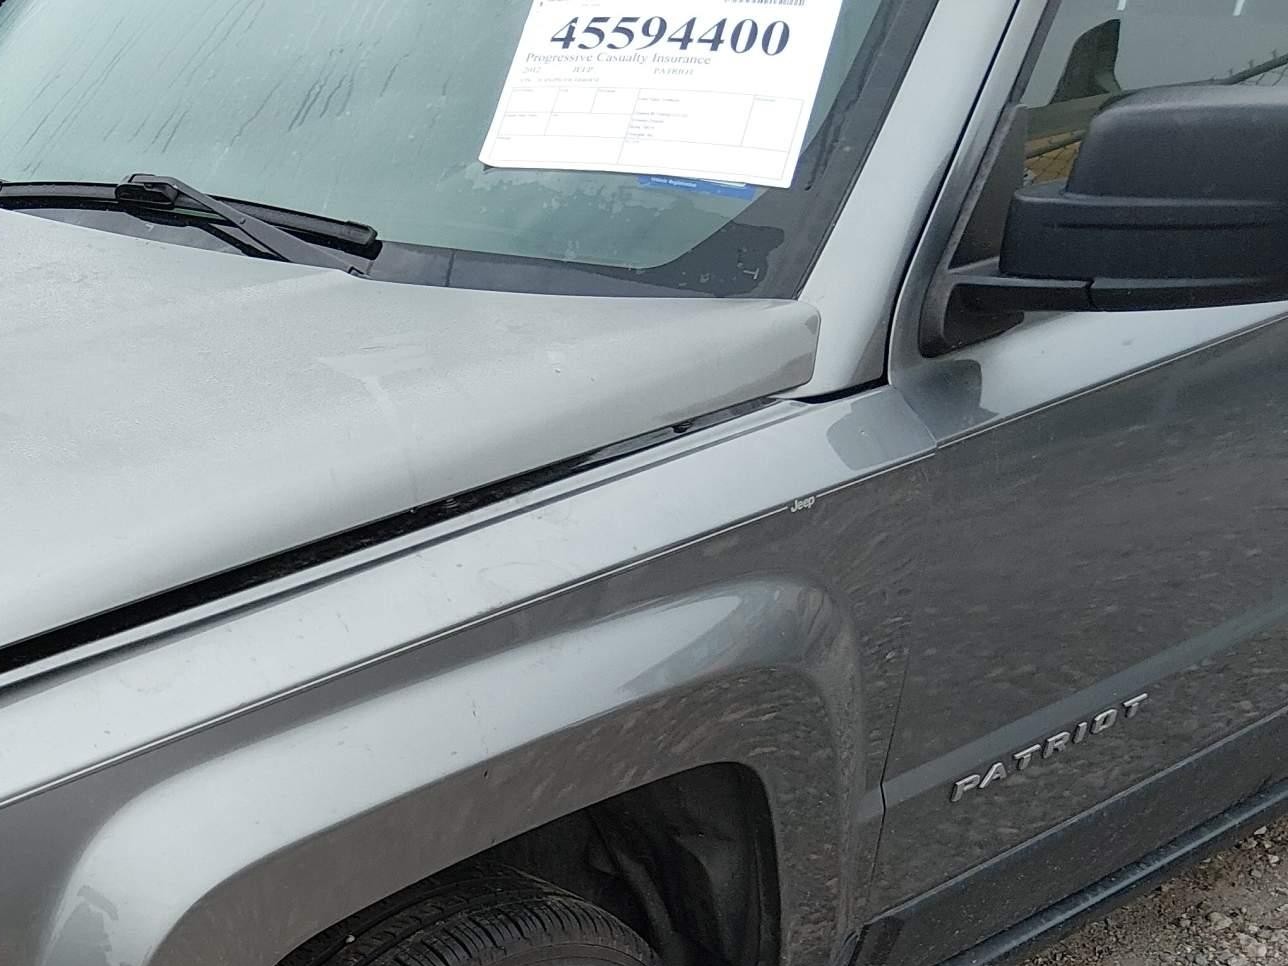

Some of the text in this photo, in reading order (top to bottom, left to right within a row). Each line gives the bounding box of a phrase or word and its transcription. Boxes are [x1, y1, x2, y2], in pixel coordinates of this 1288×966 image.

[550, 16, 791, 56] 45594400
[525, 52, 711, 65] Progressive Casualty Insurance
[790, 496, 815, 513] Jeep
[949, 692, 1148, 802] PATRIOT
